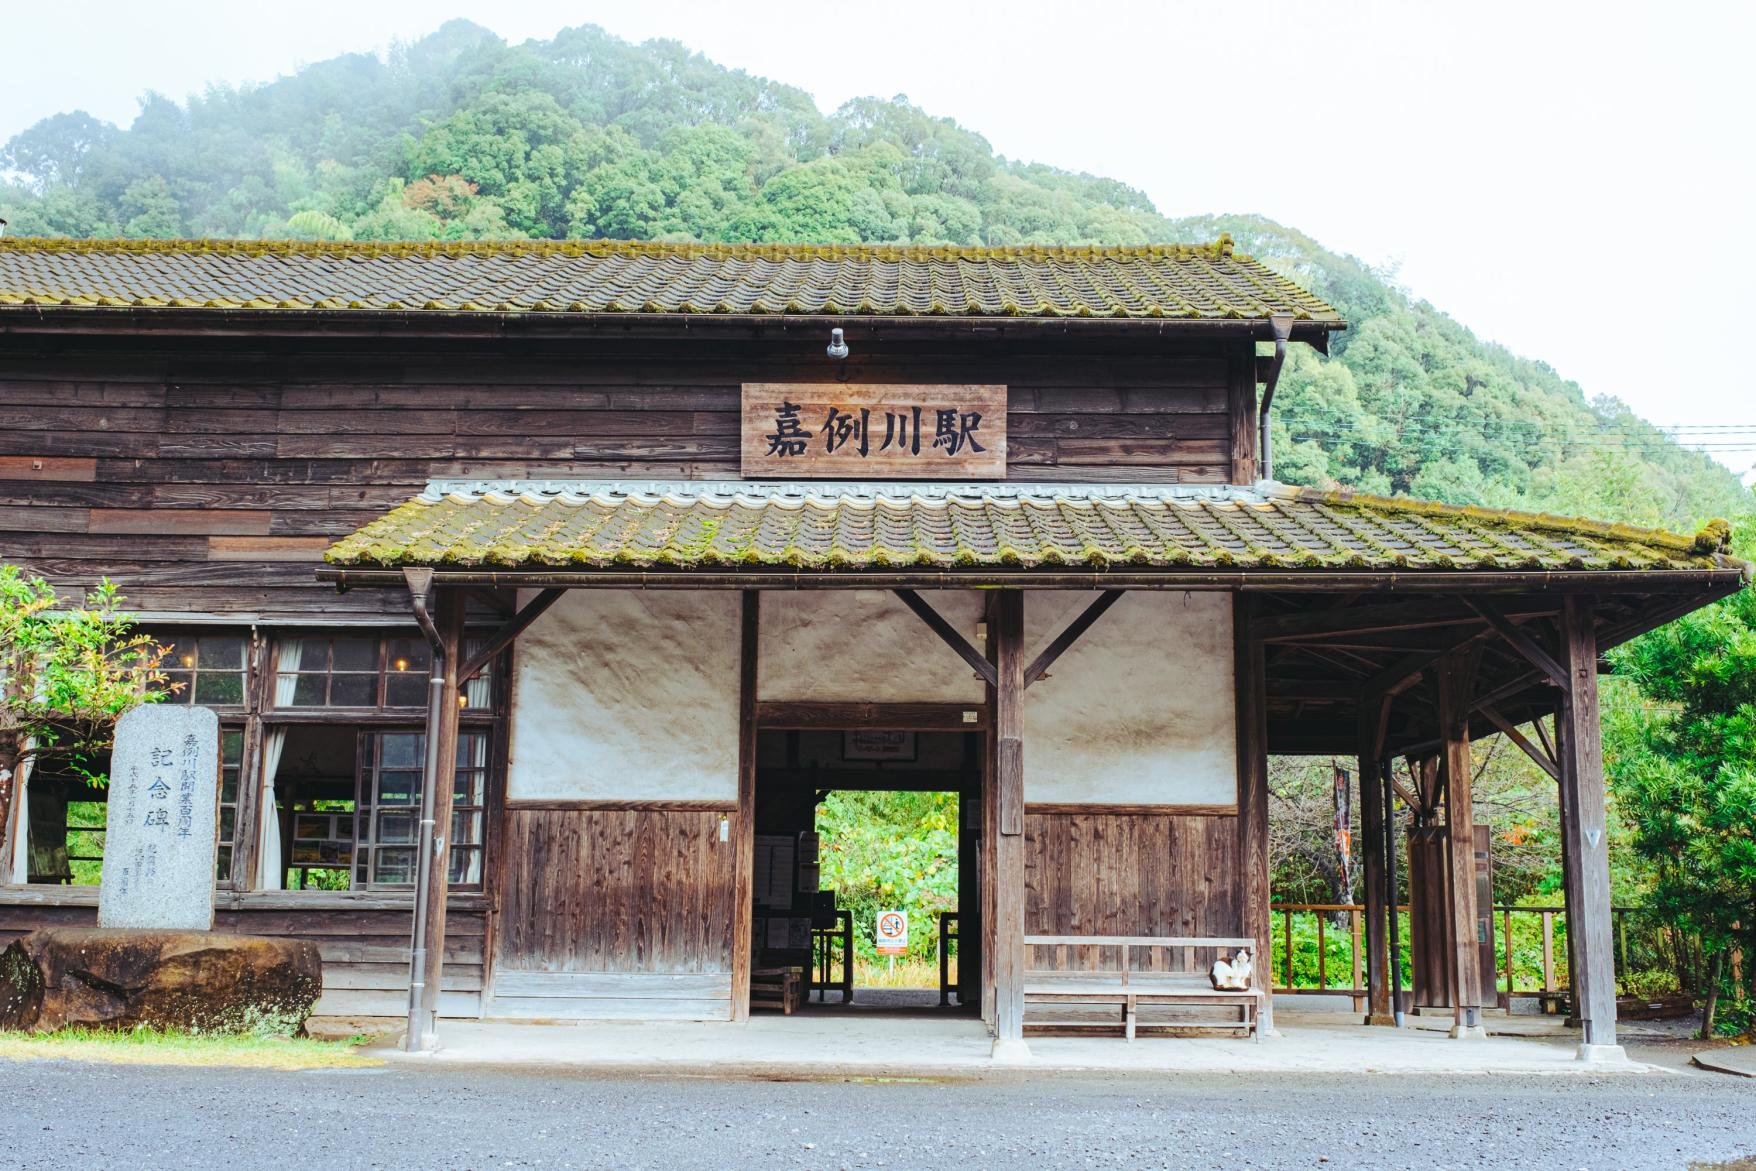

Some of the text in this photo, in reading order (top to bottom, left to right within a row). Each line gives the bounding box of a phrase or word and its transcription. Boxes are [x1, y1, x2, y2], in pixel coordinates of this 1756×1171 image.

[765, 401, 987, 458] 嘉例川駅
[144, 747, 174, 833] 記念碑
[177, 733, 200, 838] 嘉例川駅開業百周年
